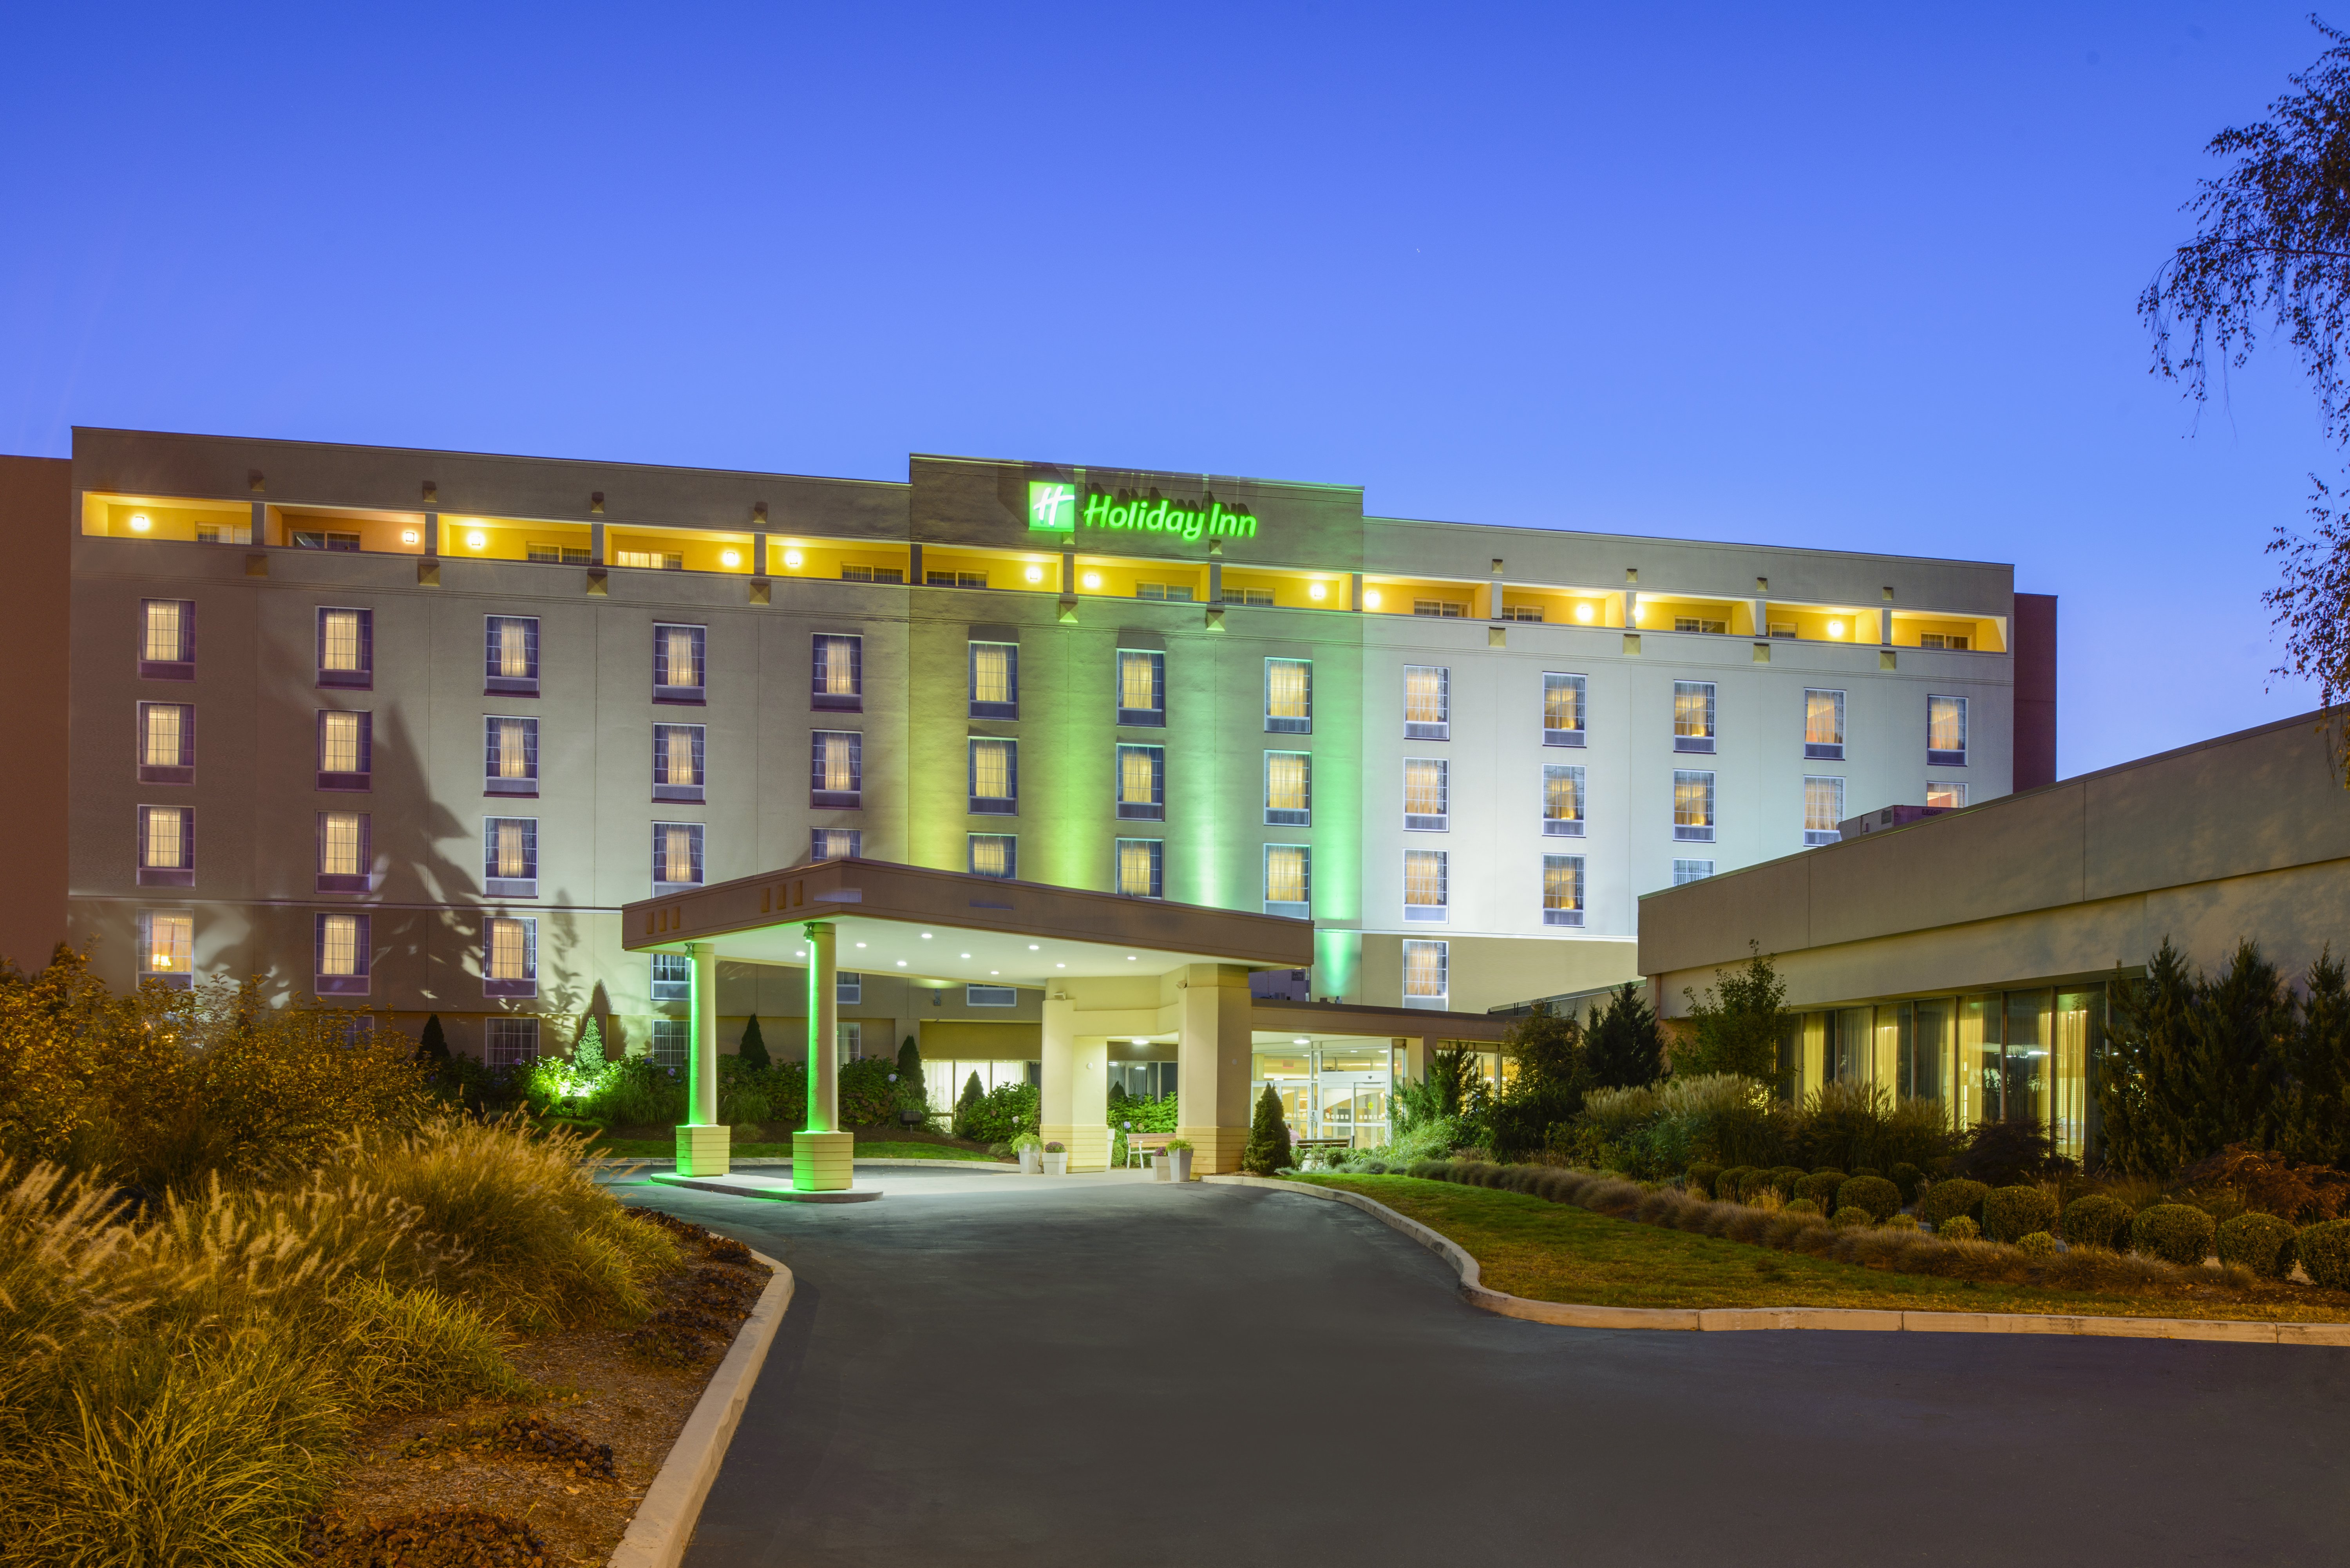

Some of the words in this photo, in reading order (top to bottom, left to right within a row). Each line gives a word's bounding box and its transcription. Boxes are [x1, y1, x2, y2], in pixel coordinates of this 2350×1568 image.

[1033, 486, 1075, 525] H
[1084, 494, 1205, 541] Holiday
[1208, 503, 1257, 537] Inn
